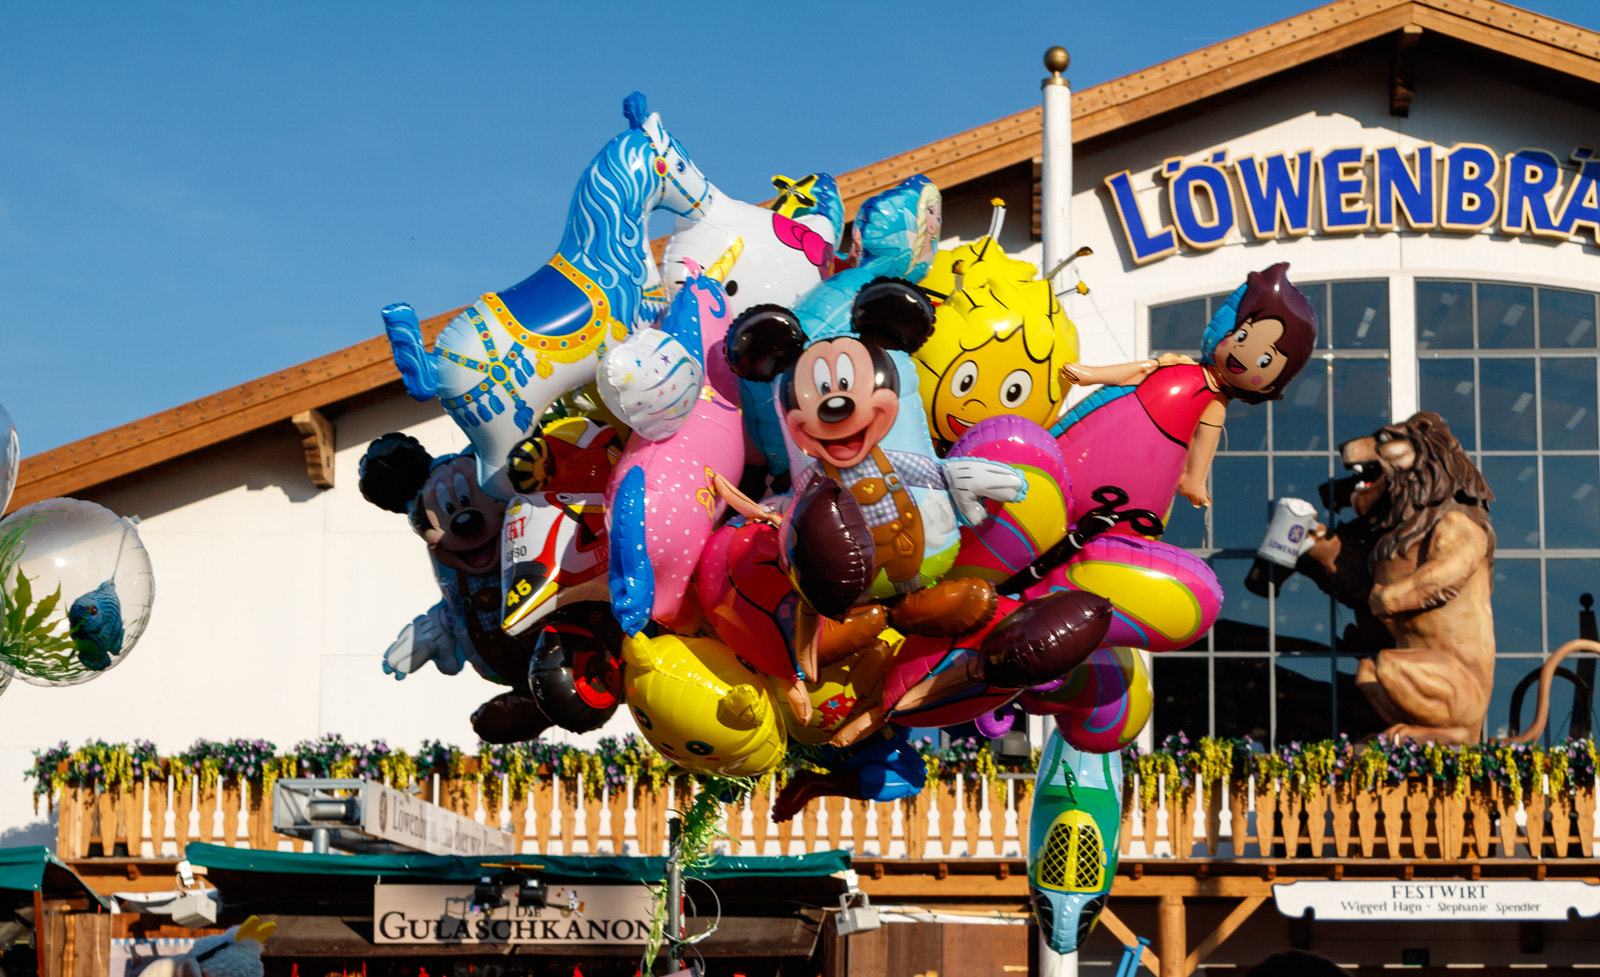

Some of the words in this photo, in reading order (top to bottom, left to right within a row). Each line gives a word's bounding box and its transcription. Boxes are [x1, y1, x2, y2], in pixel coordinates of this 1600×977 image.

[1391, 885, 1489, 899] FESTWIRT
[1340, 901, 1387, 915] Wiggerl
[1393, 901, 1422, 915] Hagn
[1496, 901, 1541, 915] Spendler
[379, 910, 657, 941] GULASCHKANON
